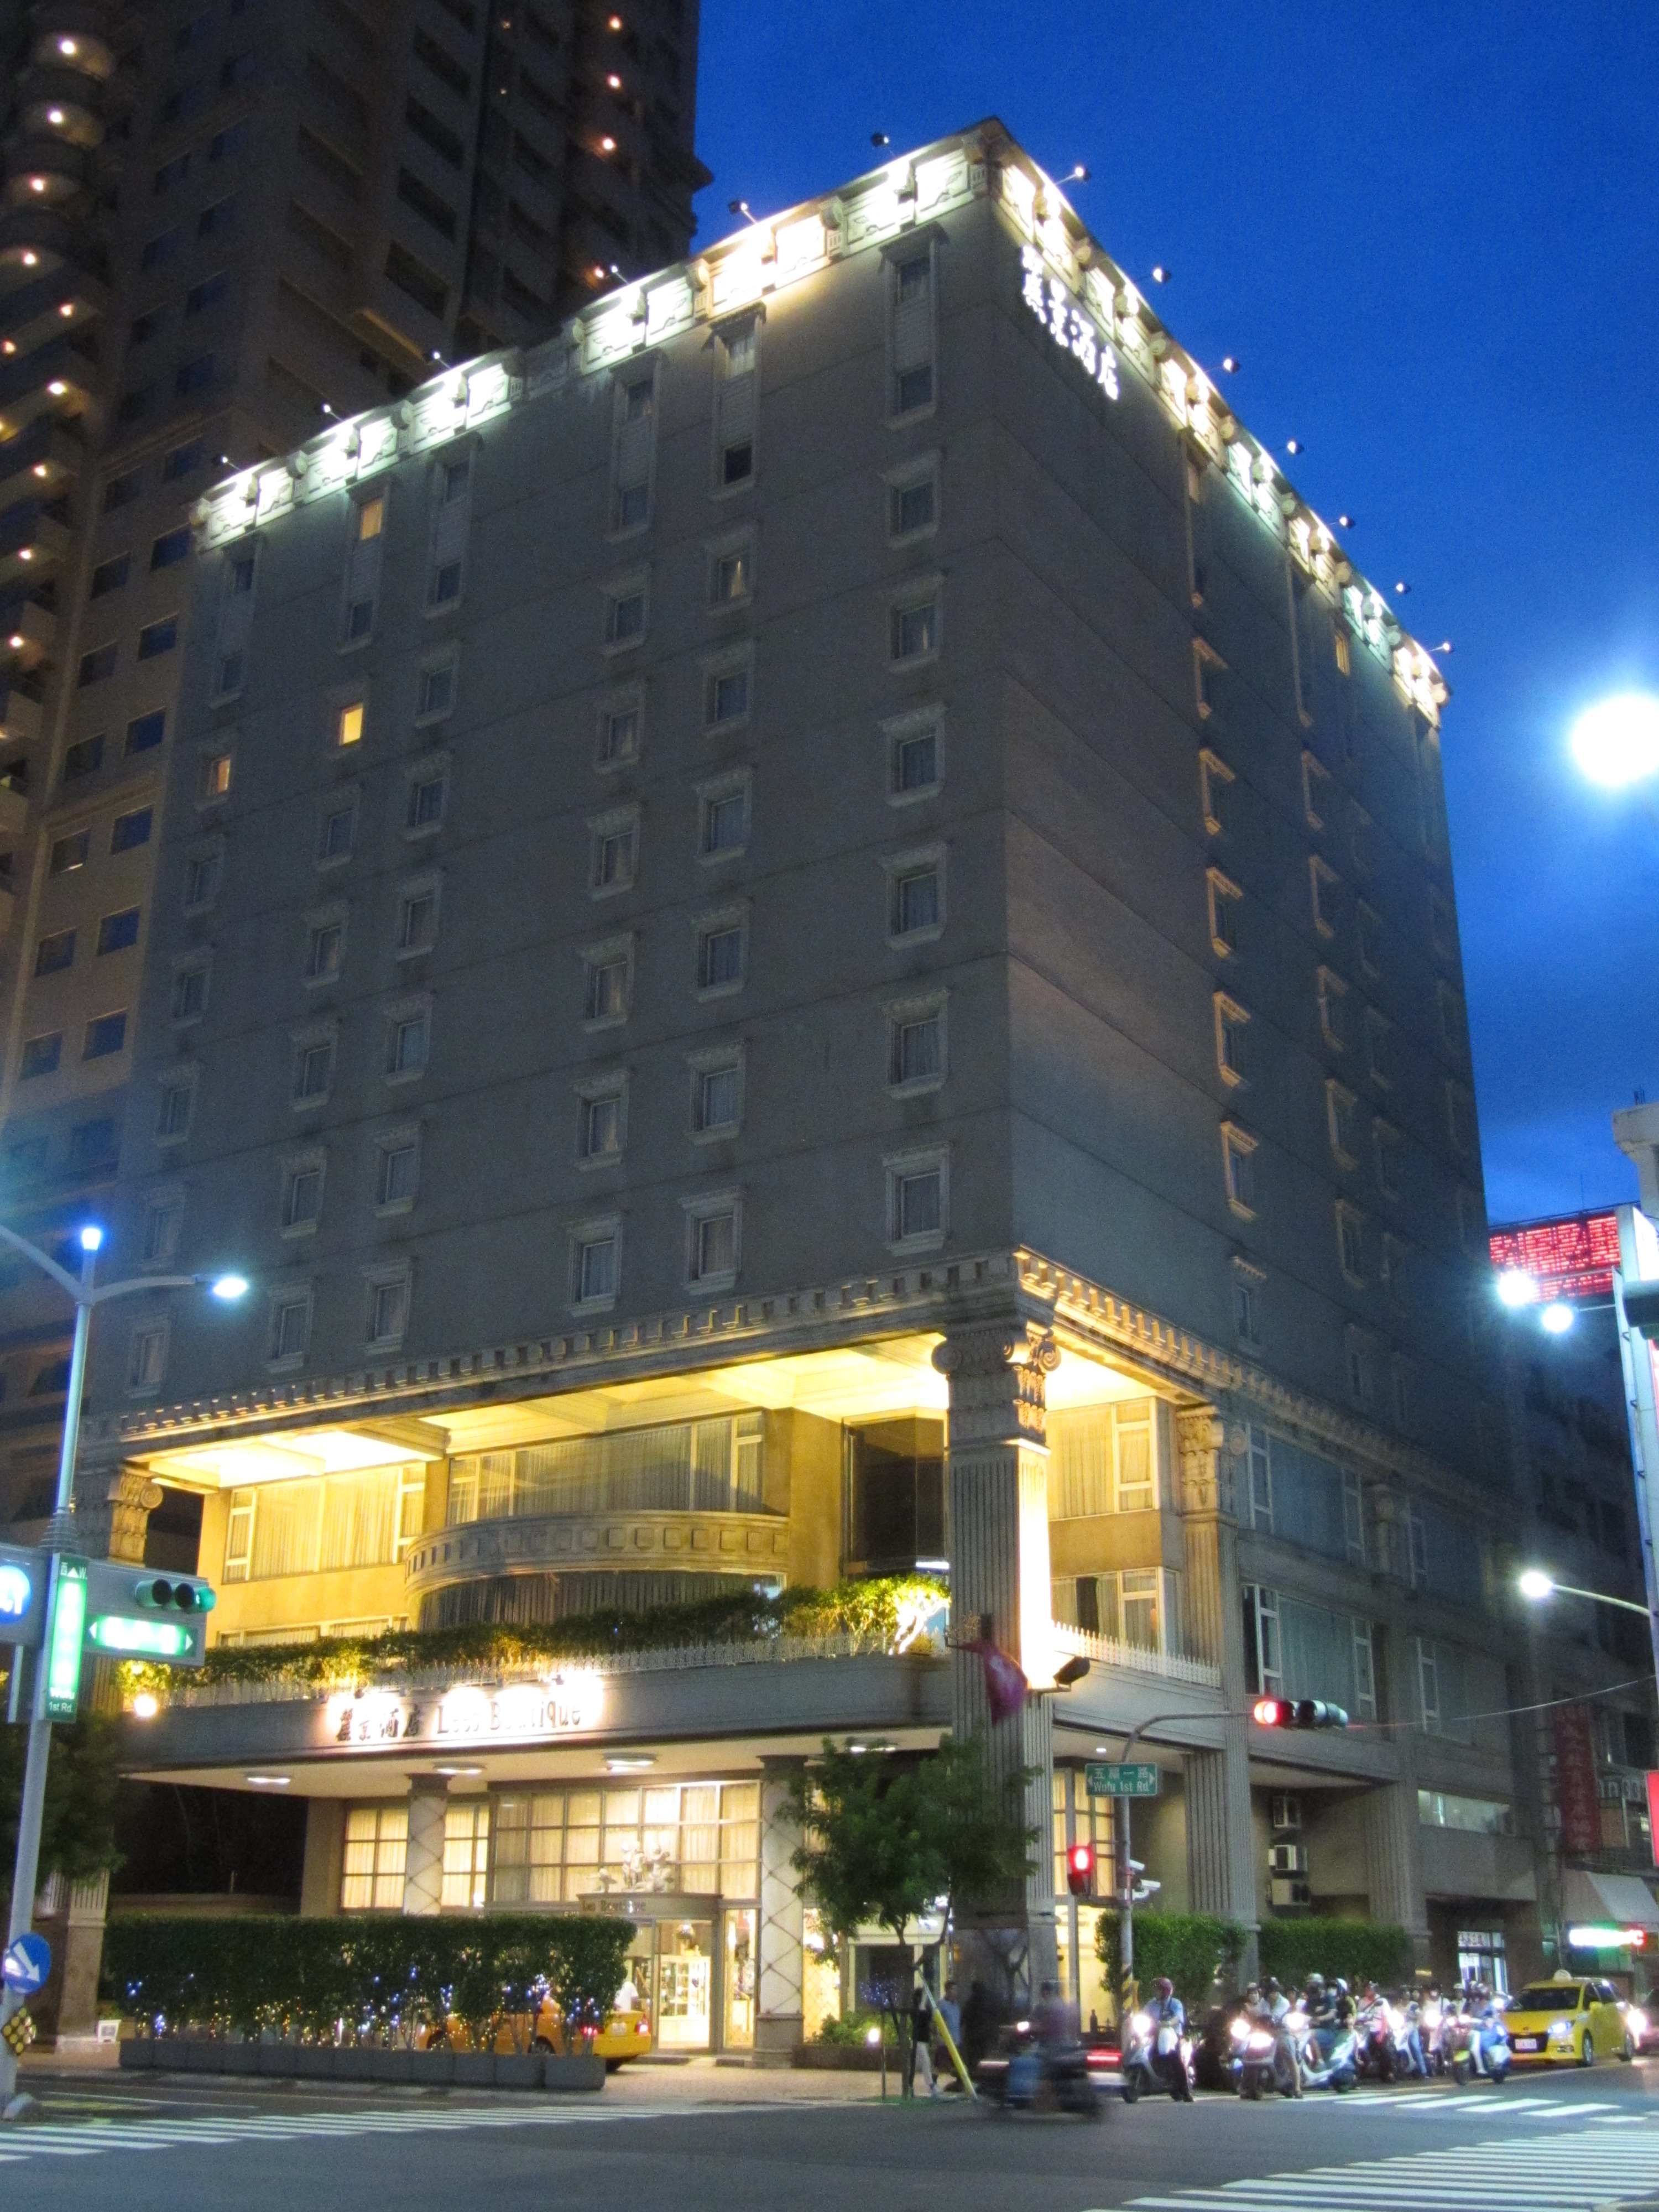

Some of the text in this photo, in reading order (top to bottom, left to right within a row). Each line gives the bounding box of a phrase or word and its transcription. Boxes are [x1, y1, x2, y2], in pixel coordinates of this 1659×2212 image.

[49, 1702, 59, 1712] 1st
[491, 1700, 581, 1730] Btique
[1094, 1781, 1115, 1792] Wufu
[1120, 1781, 1133, 1792] 1st
